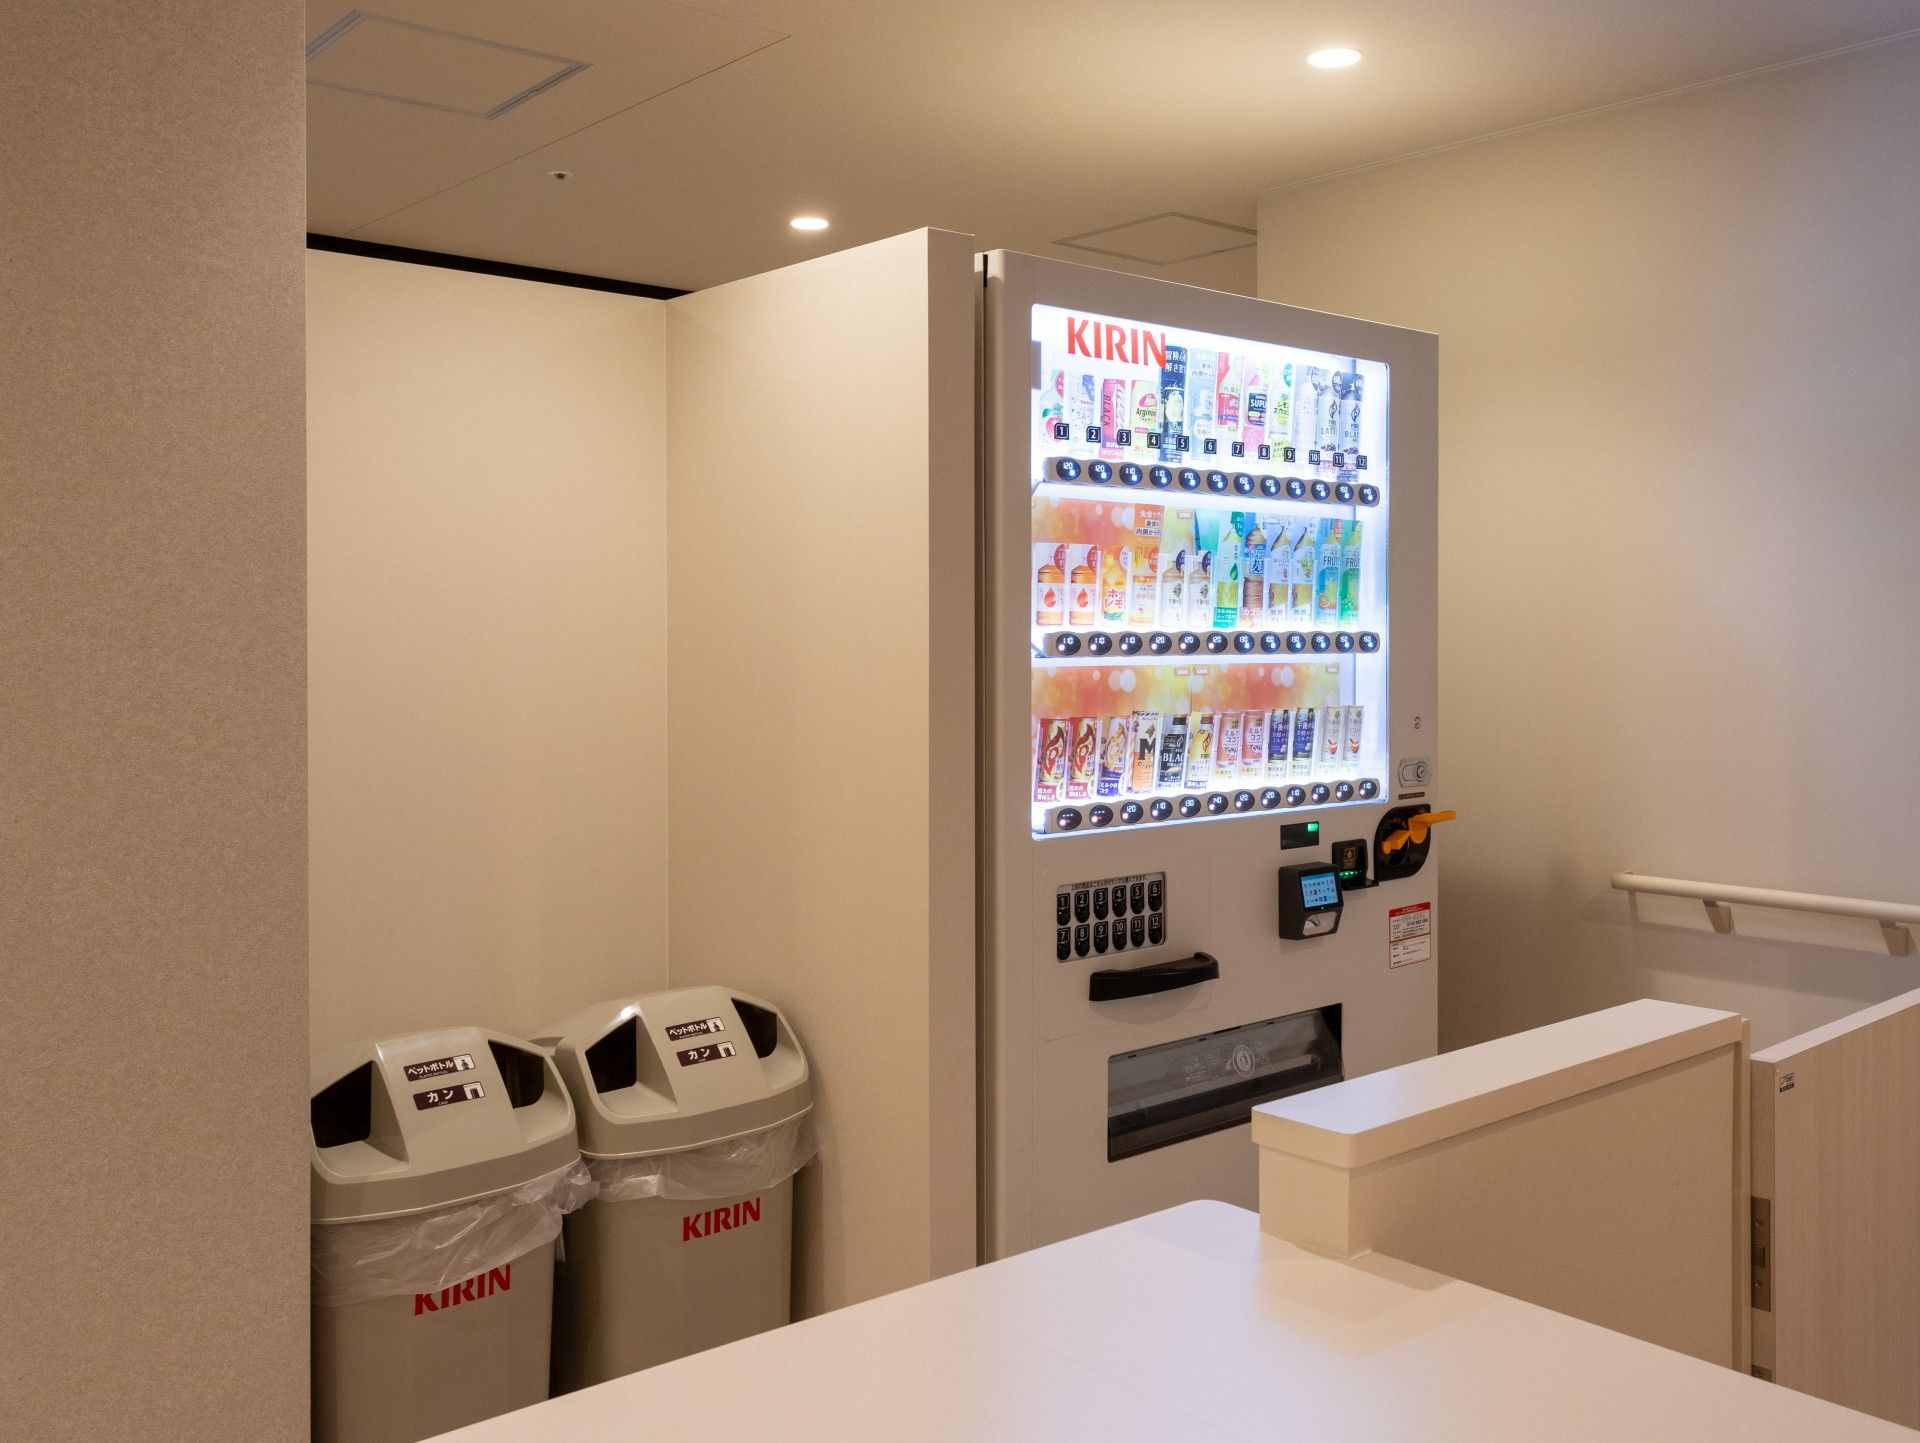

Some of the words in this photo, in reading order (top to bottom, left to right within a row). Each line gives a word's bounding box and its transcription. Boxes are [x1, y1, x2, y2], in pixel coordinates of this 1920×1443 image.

[1066, 316, 1167, 369] KIRIN
[1061, 898, 1064, 906] 1
[1080, 895, 1084, 903] 2
[1099, 892, 1103, 901] 3
[1117, 889, 1121, 898] 4
[1136, 886, 1140, 895] 5
[1153, 884, 1157, 893] 6
[1061, 932, 1065, 940] 7
[1080, 928, 1084, 937] 8
[1099, 925, 1103, 934] 9
[1116, 922, 1123, 931] 10
[1134, 920, 1140, 928] 11
[1152, 917, 1159, 925] 12
[668, 1022, 708, 1036] ペットボトル
[688, 1048, 710, 1060] カン
[408, 1060, 454, 1075] ペットボトル
[426, 1090, 454, 1103] カン
[682, 1197, 761, 1242] KIRIN
[414, 1263, 511, 1316] KIRIN
